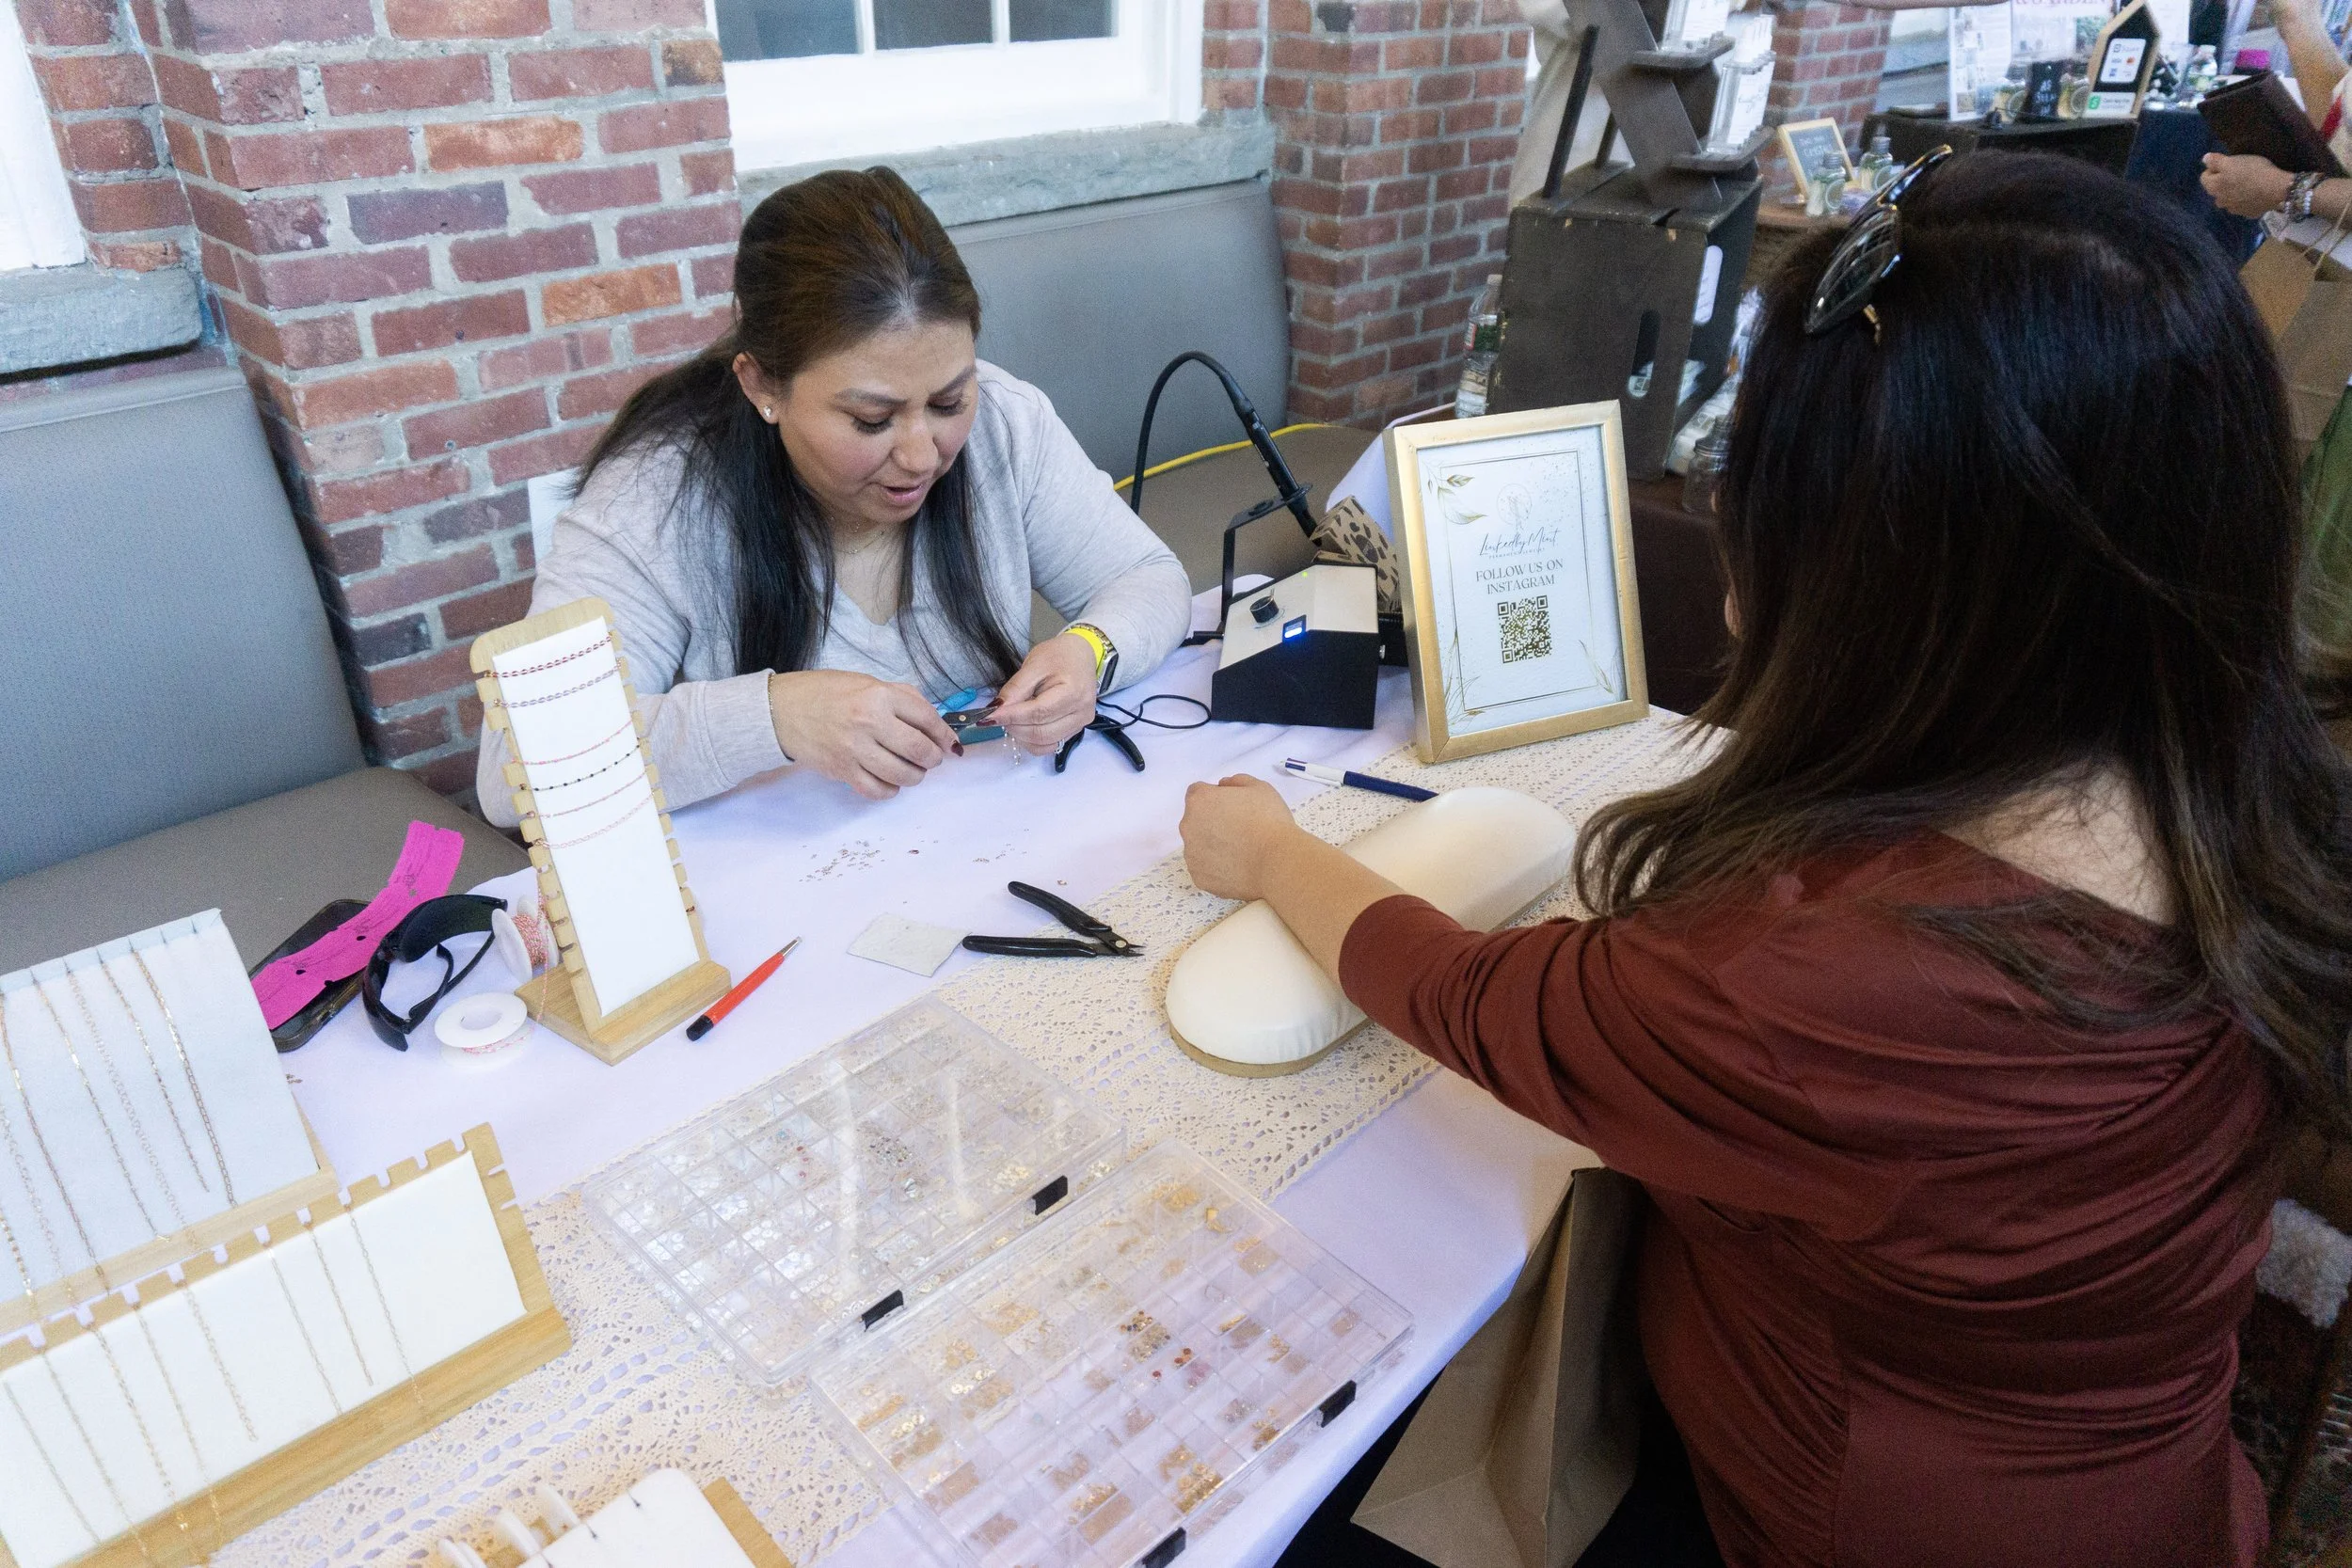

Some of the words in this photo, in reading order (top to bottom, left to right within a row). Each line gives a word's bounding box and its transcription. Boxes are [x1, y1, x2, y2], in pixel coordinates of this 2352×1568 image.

[1476, 564, 1525, 581] FOLLOW
[1529, 562, 1543, 573] US
[1547, 558, 1563, 571] ON
[1487, 574, 1555, 594] INSTAGRAM
